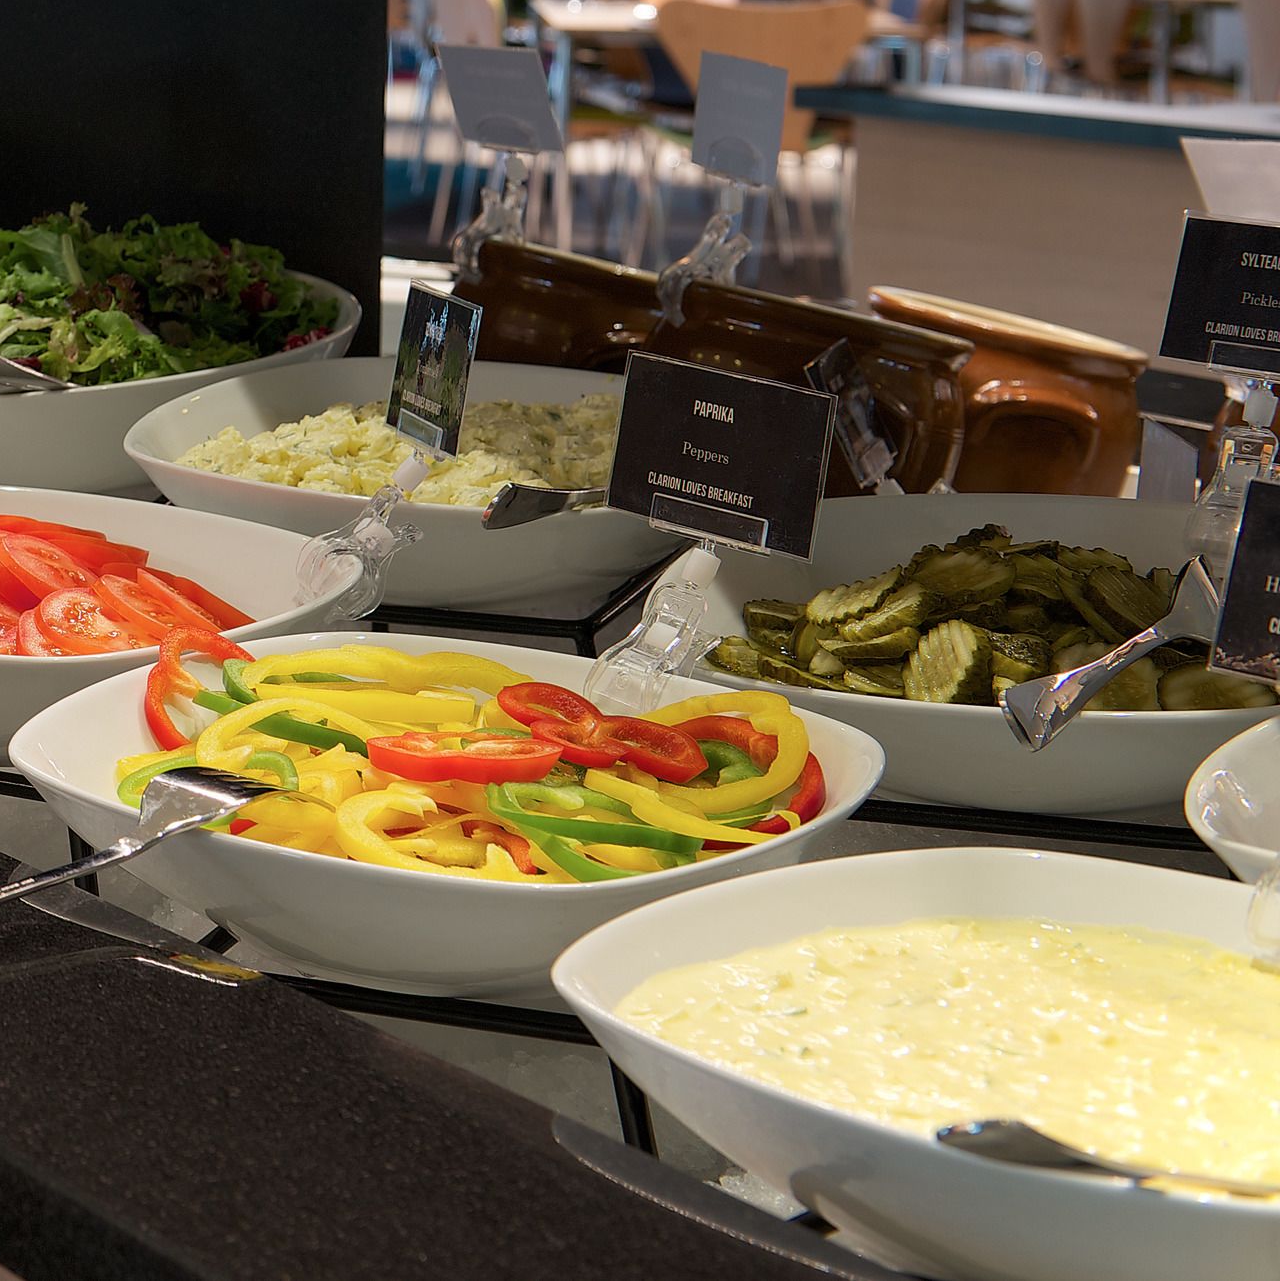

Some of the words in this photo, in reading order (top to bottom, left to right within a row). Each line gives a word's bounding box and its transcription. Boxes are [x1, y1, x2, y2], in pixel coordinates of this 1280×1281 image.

[1205, 321, 1240, 337] CLARION
[1240, 326, 1267, 340] LOVES
[693, 400, 735, 424] PAPRIKA
[681, 441, 730, 465] Peppers
[648, 471, 681, 491] CLARION
[681, 479, 707, 497] LOVES
[707, 485, 754, 509] BREAKFAST
